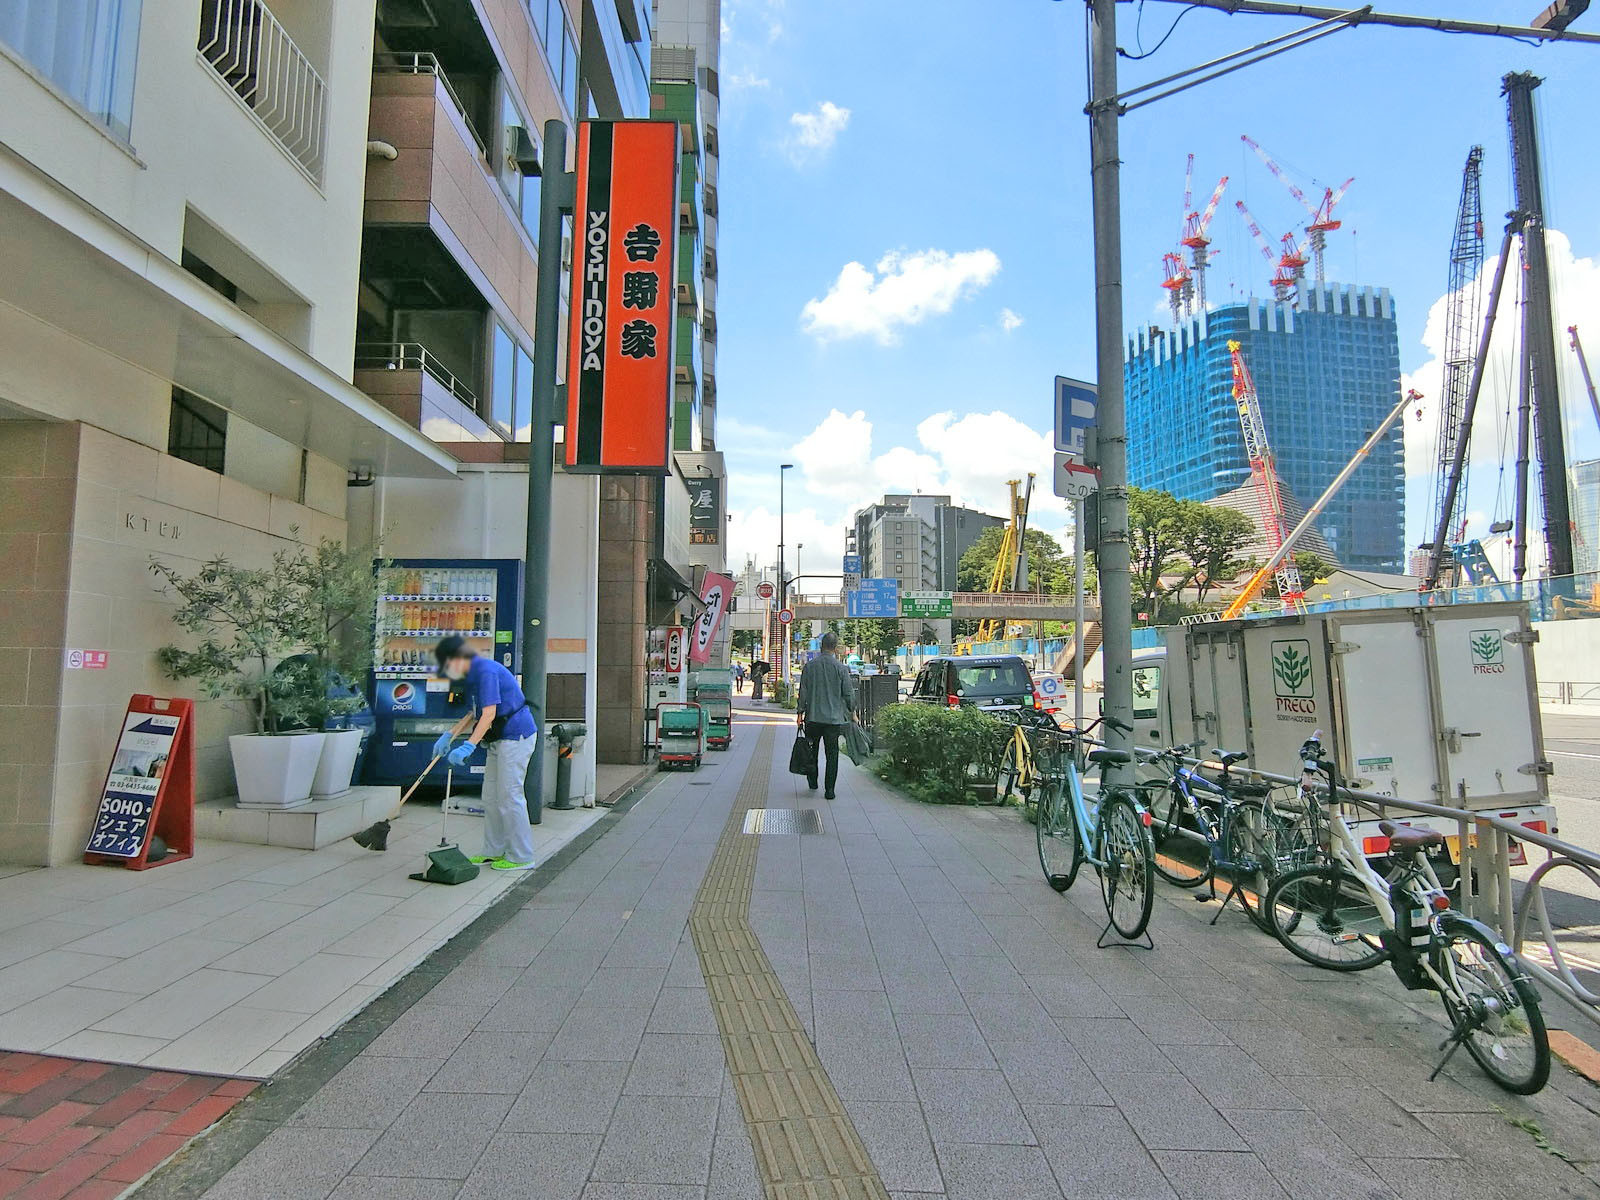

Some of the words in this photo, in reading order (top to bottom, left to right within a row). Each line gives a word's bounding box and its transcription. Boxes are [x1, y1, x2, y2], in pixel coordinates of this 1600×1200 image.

[620, 223, 661, 360] 吉野家
[1062, 383, 1098, 446] P
[781, 612, 790, 621] 50
[670, 634, 680, 665] たばこ
[1472, 664, 1505, 674] PRECO
[392, 704, 413, 712] pepsi
[1276, 697, 1316, 713] PRECO
[100, 815, 147, 834] シェア
[93, 832, 142, 851] オフィス
